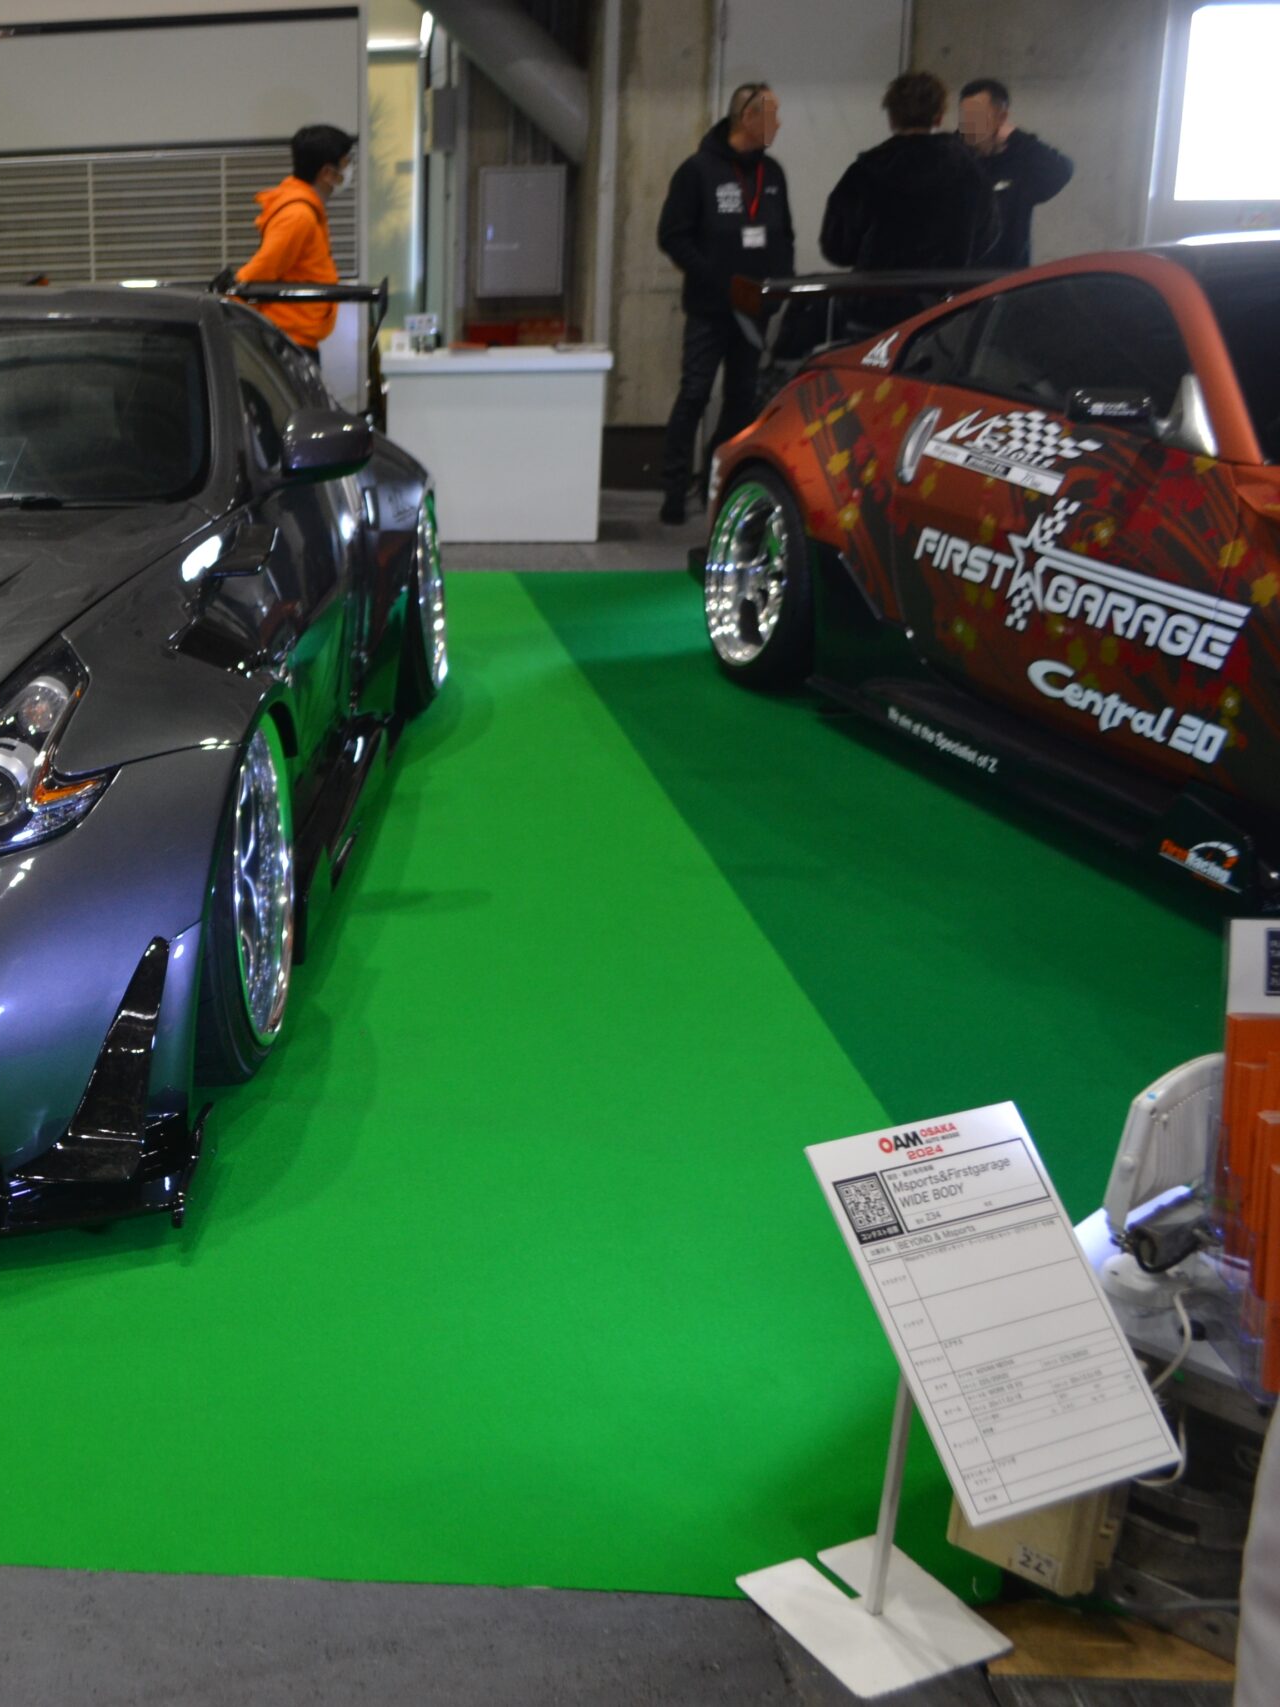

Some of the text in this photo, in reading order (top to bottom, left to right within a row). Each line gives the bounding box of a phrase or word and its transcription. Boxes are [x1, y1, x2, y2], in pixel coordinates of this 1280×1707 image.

[914, 526, 1239, 671] FIRST GARAGE
[1027, 659, 1228, 764] Central 20
[987, 758, 999, 773] Z
[878, 1122, 957, 1154] OAM OSAKA
[906, 1144, 945, 1161] 2024
[892, 1157, 1011, 1194] Msports&Firstgarage
[898, 1182, 964, 1209] WIDE BODY
[898, 1224, 976, 1250] BEYOND & Msports
